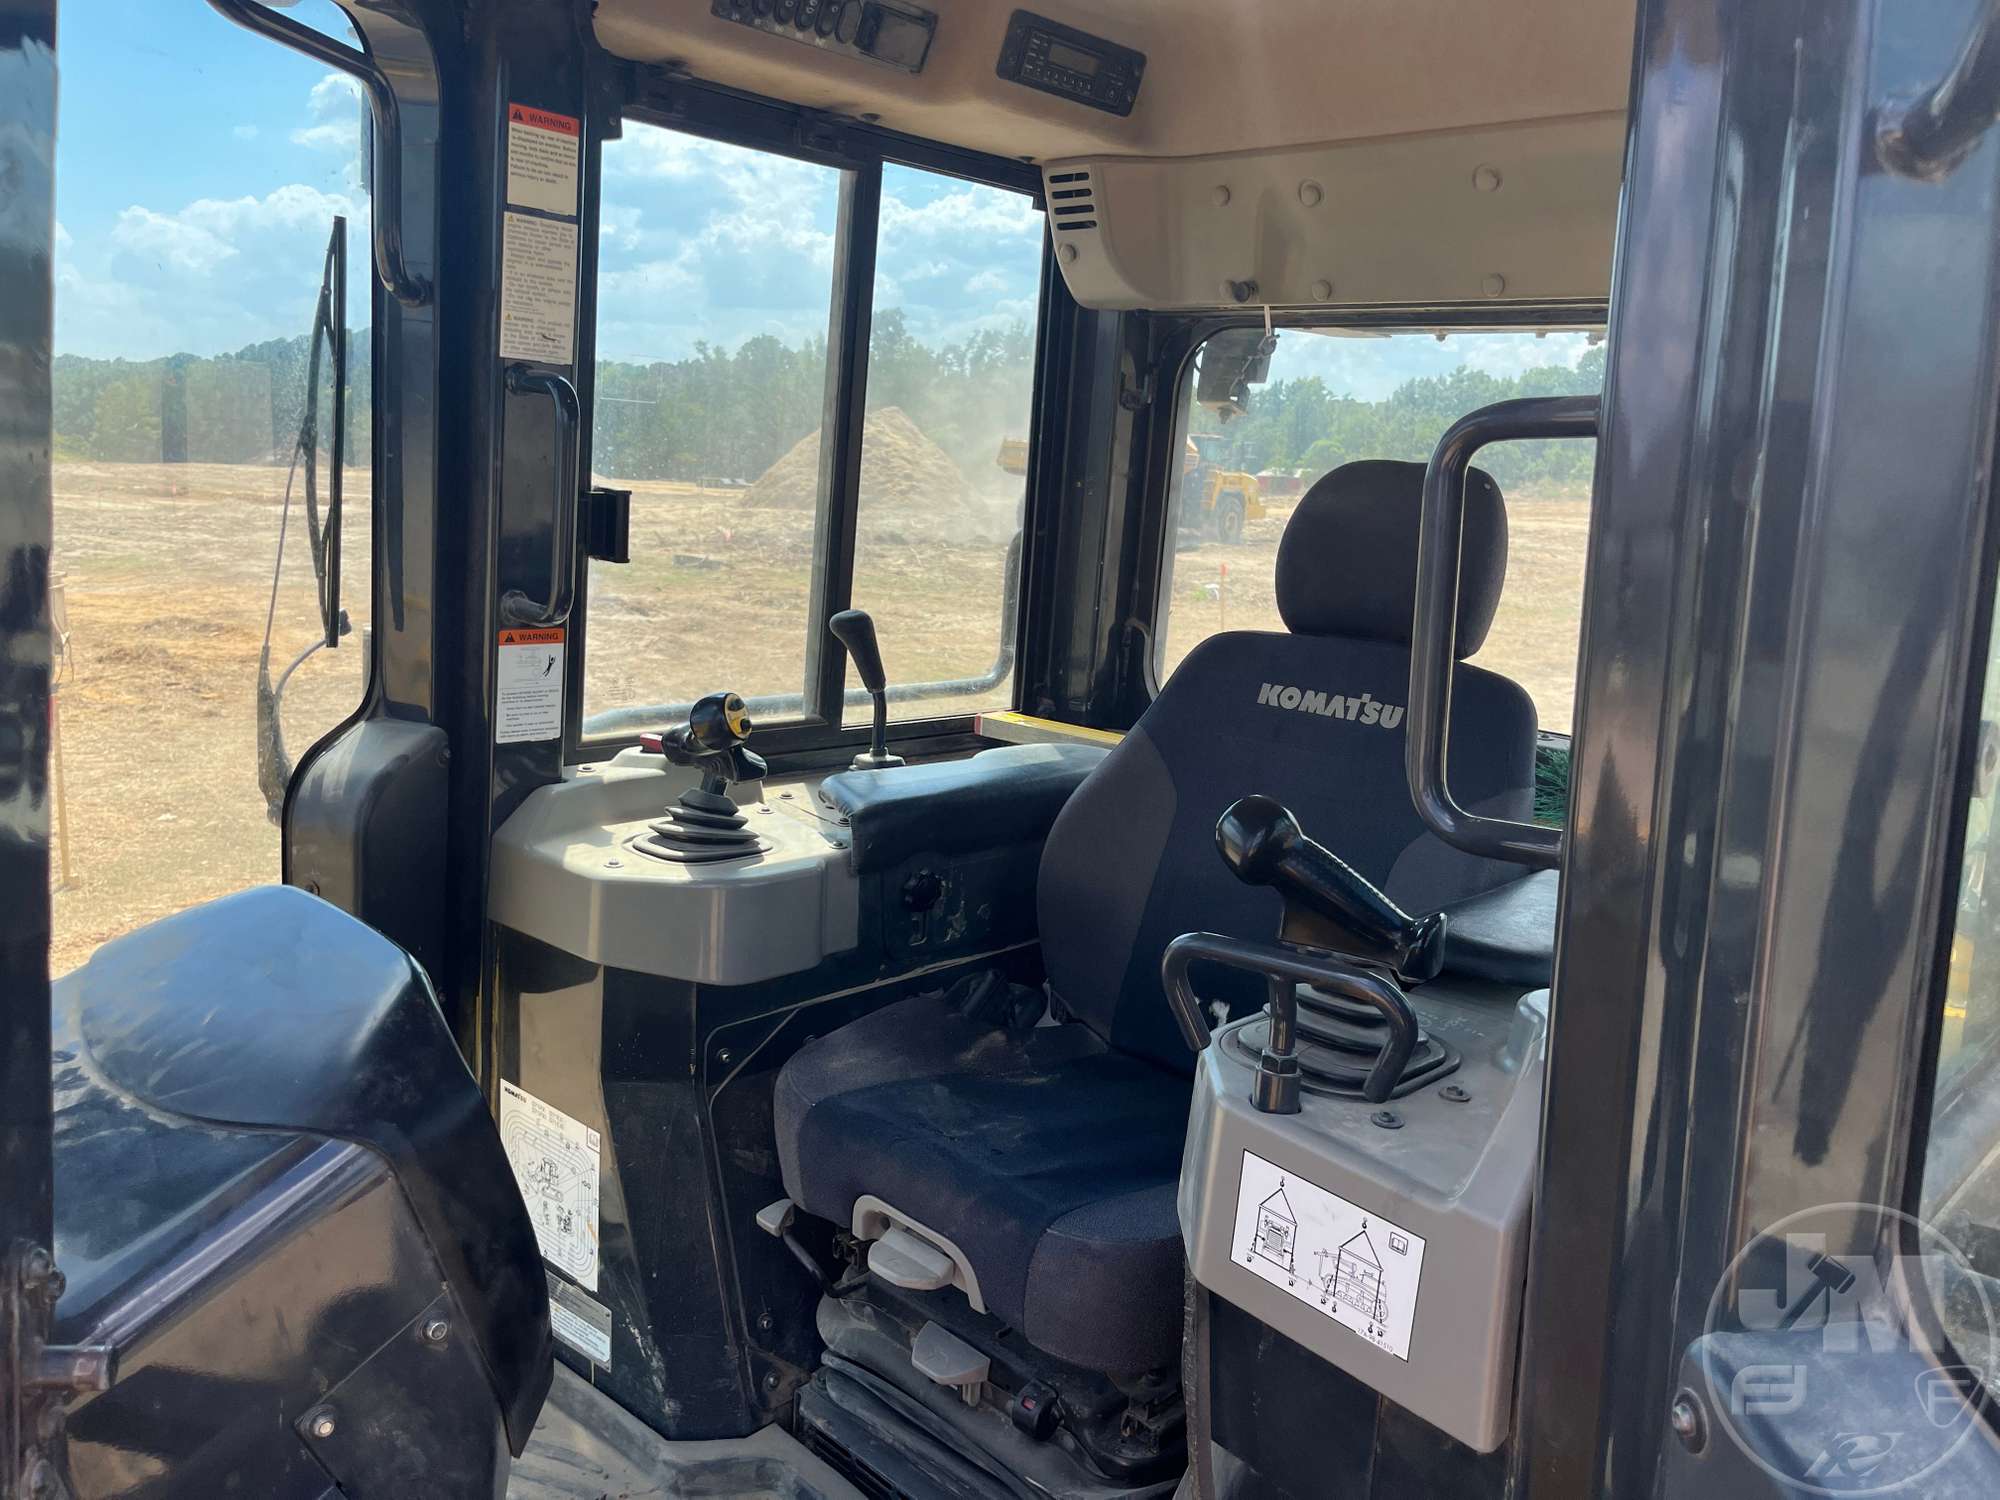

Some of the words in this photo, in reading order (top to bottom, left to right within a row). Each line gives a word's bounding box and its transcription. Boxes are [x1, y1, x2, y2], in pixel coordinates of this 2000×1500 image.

[528, 112, 571, 129] WARNING
[518, 632, 559, 641] WARNING
[1256, 682, 1404, 729] KOMATSU
